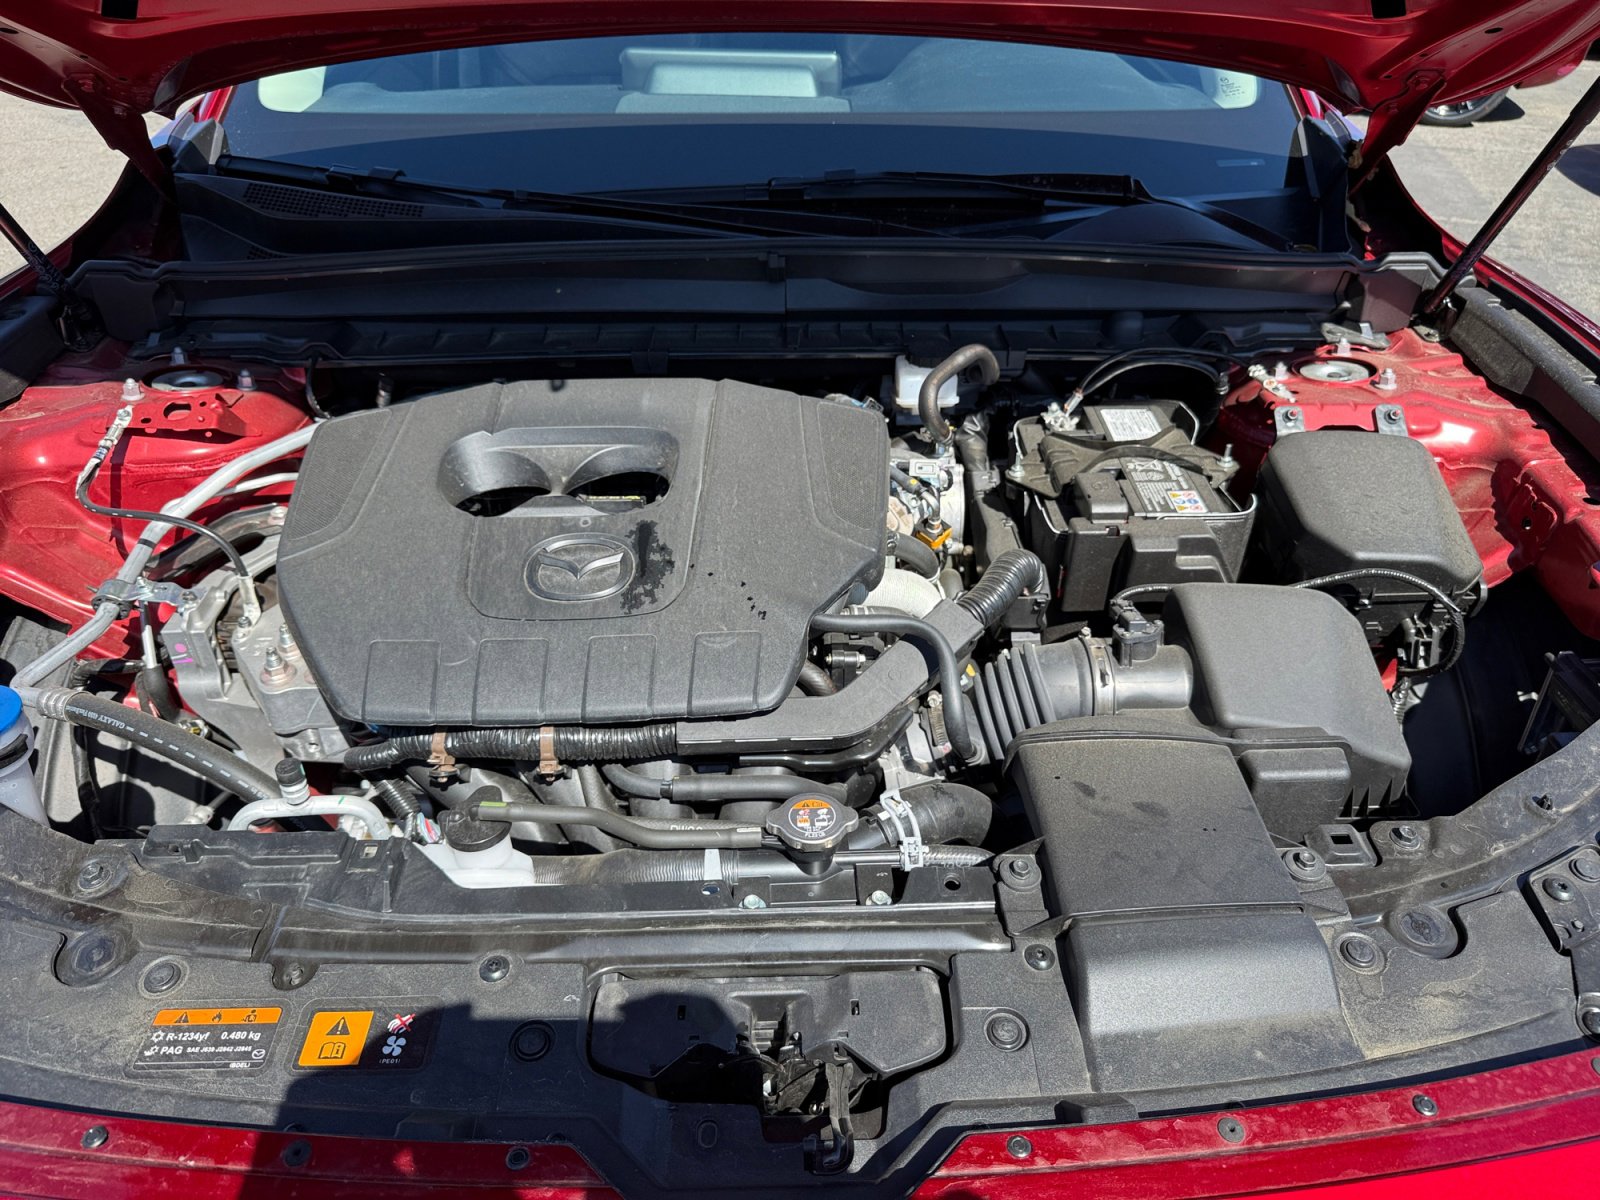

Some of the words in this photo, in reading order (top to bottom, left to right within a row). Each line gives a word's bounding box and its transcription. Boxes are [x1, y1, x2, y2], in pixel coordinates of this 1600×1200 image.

[98, 714, 125, 729] GALAXY
[166, 1031, 210, 1042] R-1234yf
[221, 1031, 247, 1040] 0.480
[248, 1031, 262, 1041] kg
[160, 1046, 183, 1055] PAG
